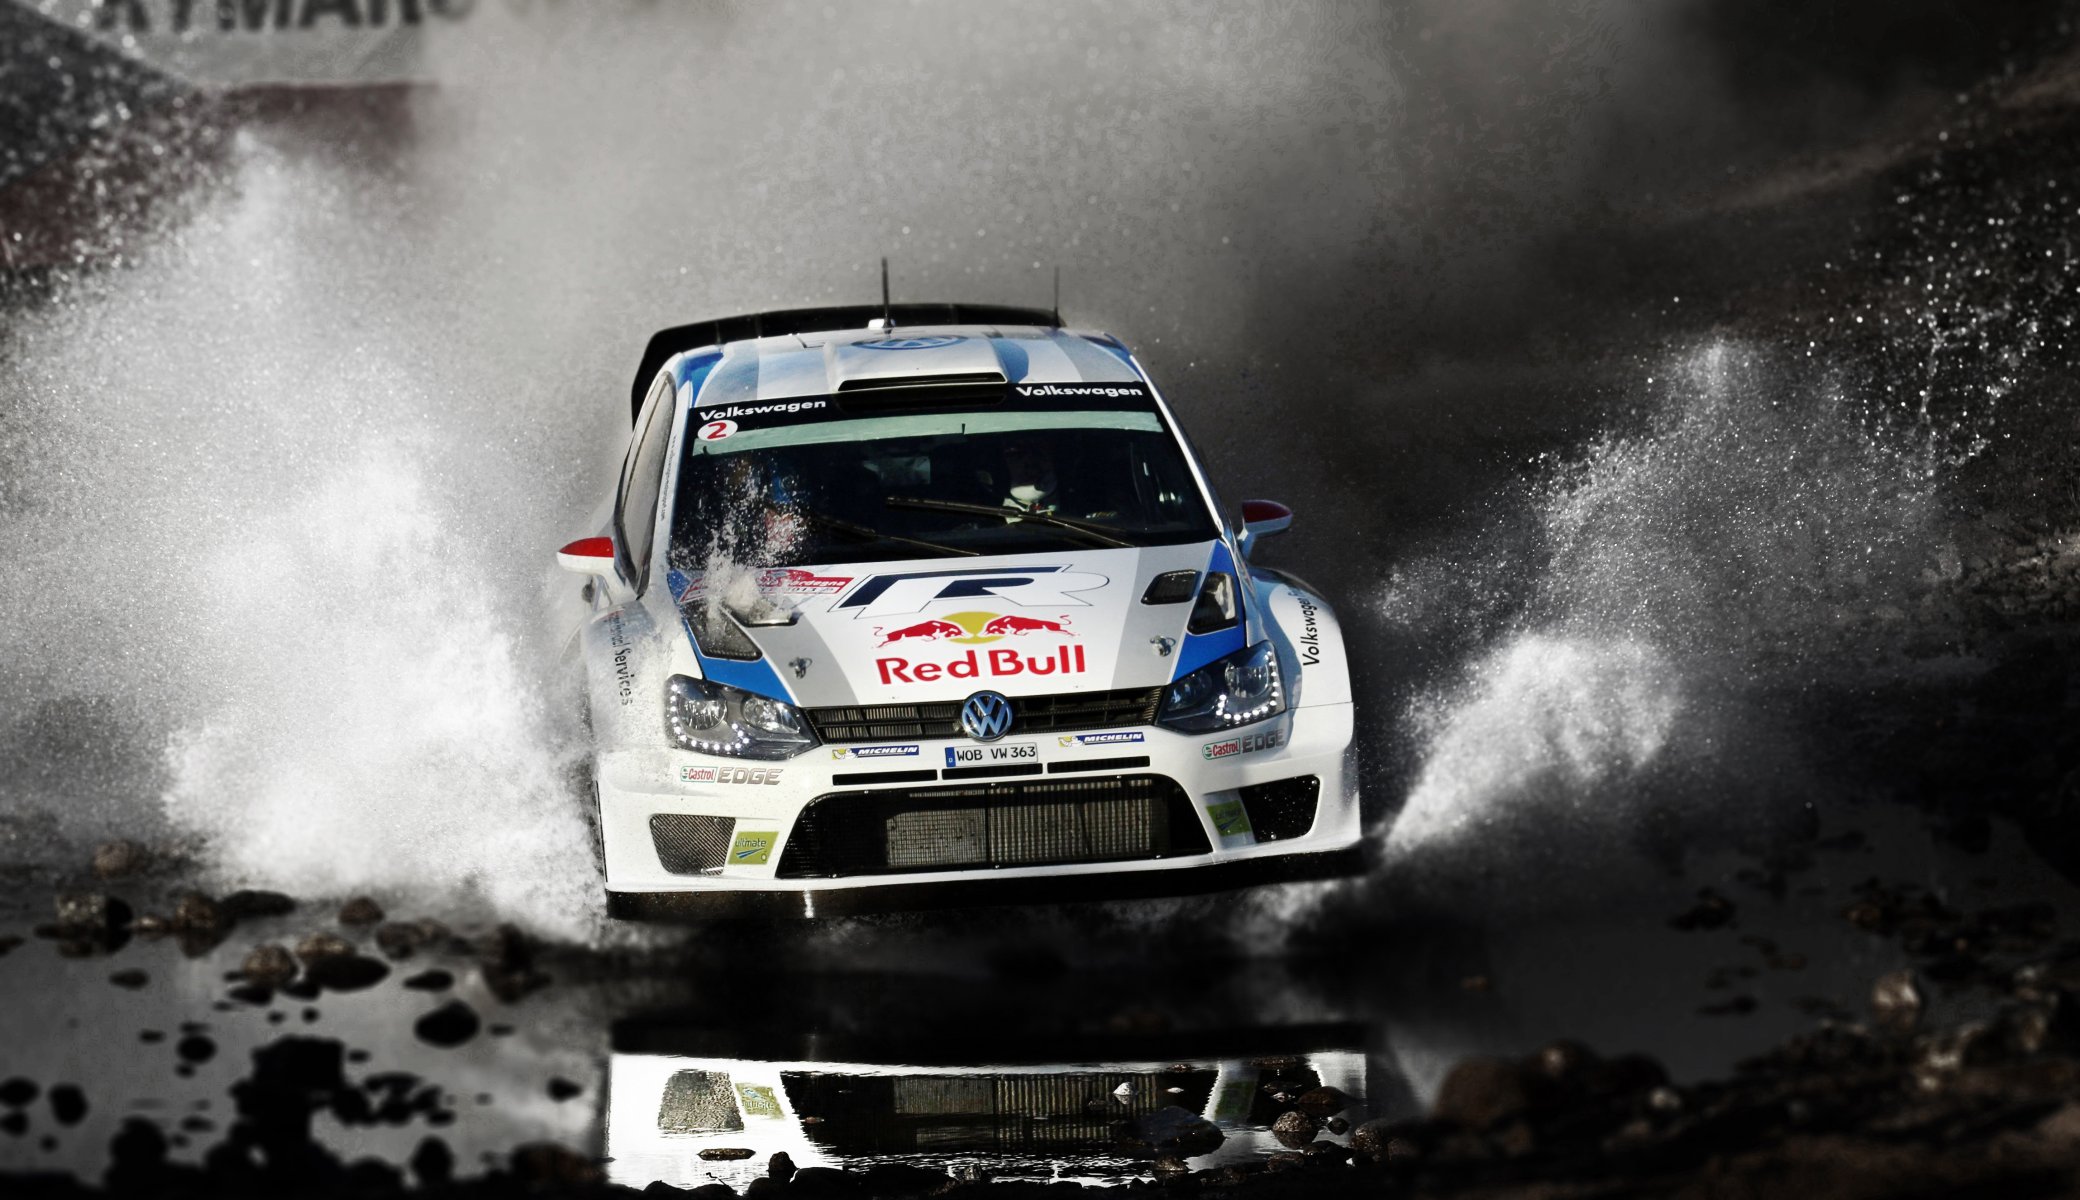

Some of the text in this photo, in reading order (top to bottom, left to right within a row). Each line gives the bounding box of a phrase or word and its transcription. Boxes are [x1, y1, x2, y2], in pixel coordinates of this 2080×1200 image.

[1016, 385, 1143, 397] Volkswagen
[700, 401, 826, 421] Volkswagen
[707, 422, 728, 439] 2
[876, 644, 1086, 685] Red Bull
[614, 647, 635, 706] Services
[1084, 733, 1143, 742] MICHELIN
[1212, 729, 1285, 756] Castrol EDGE
[858, 746, 918, 754] MICHELIN
[956, 749, 983, 761] WOB
[990, 747, 1008, 759] VW
[1010, 746, 1036, 758] 363
[688, 766, 784, 786] Castrol EDGE
